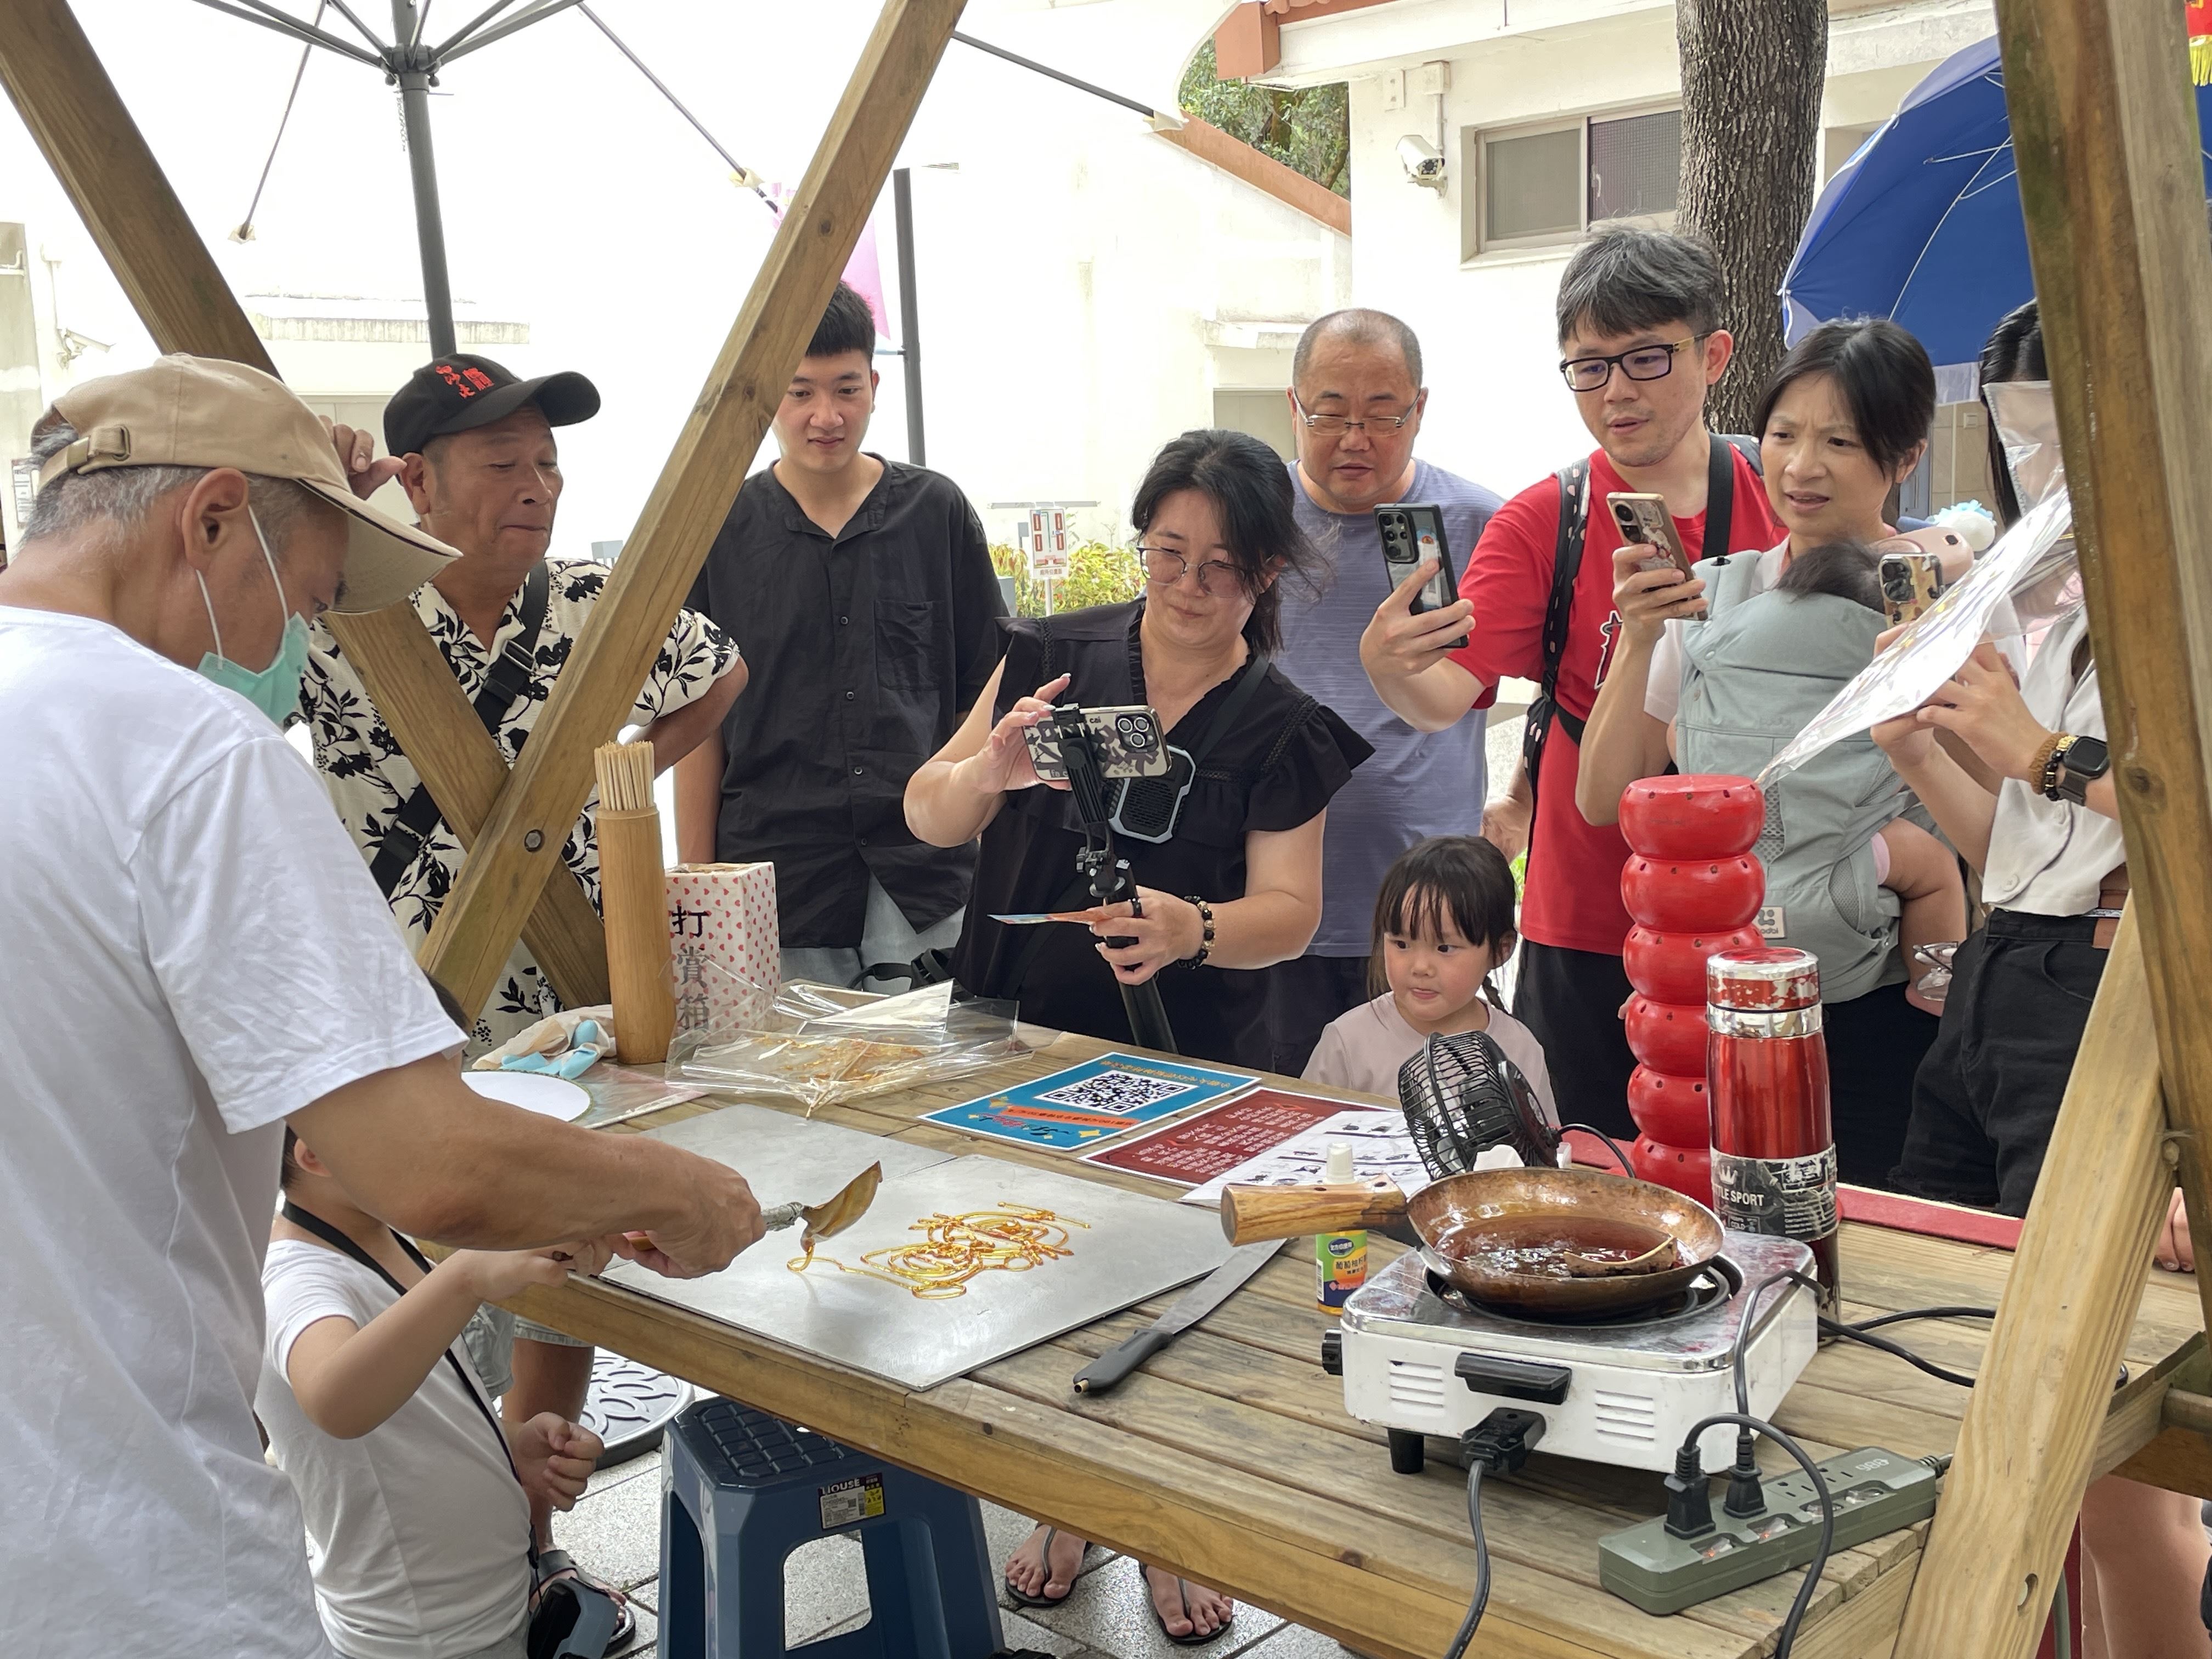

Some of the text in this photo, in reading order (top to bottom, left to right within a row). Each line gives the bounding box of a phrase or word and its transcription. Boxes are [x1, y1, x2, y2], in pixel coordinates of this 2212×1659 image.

[672, 905, 710, 1034] 打賞箱
[1730, 1190, 1765, 1206] SPORT
